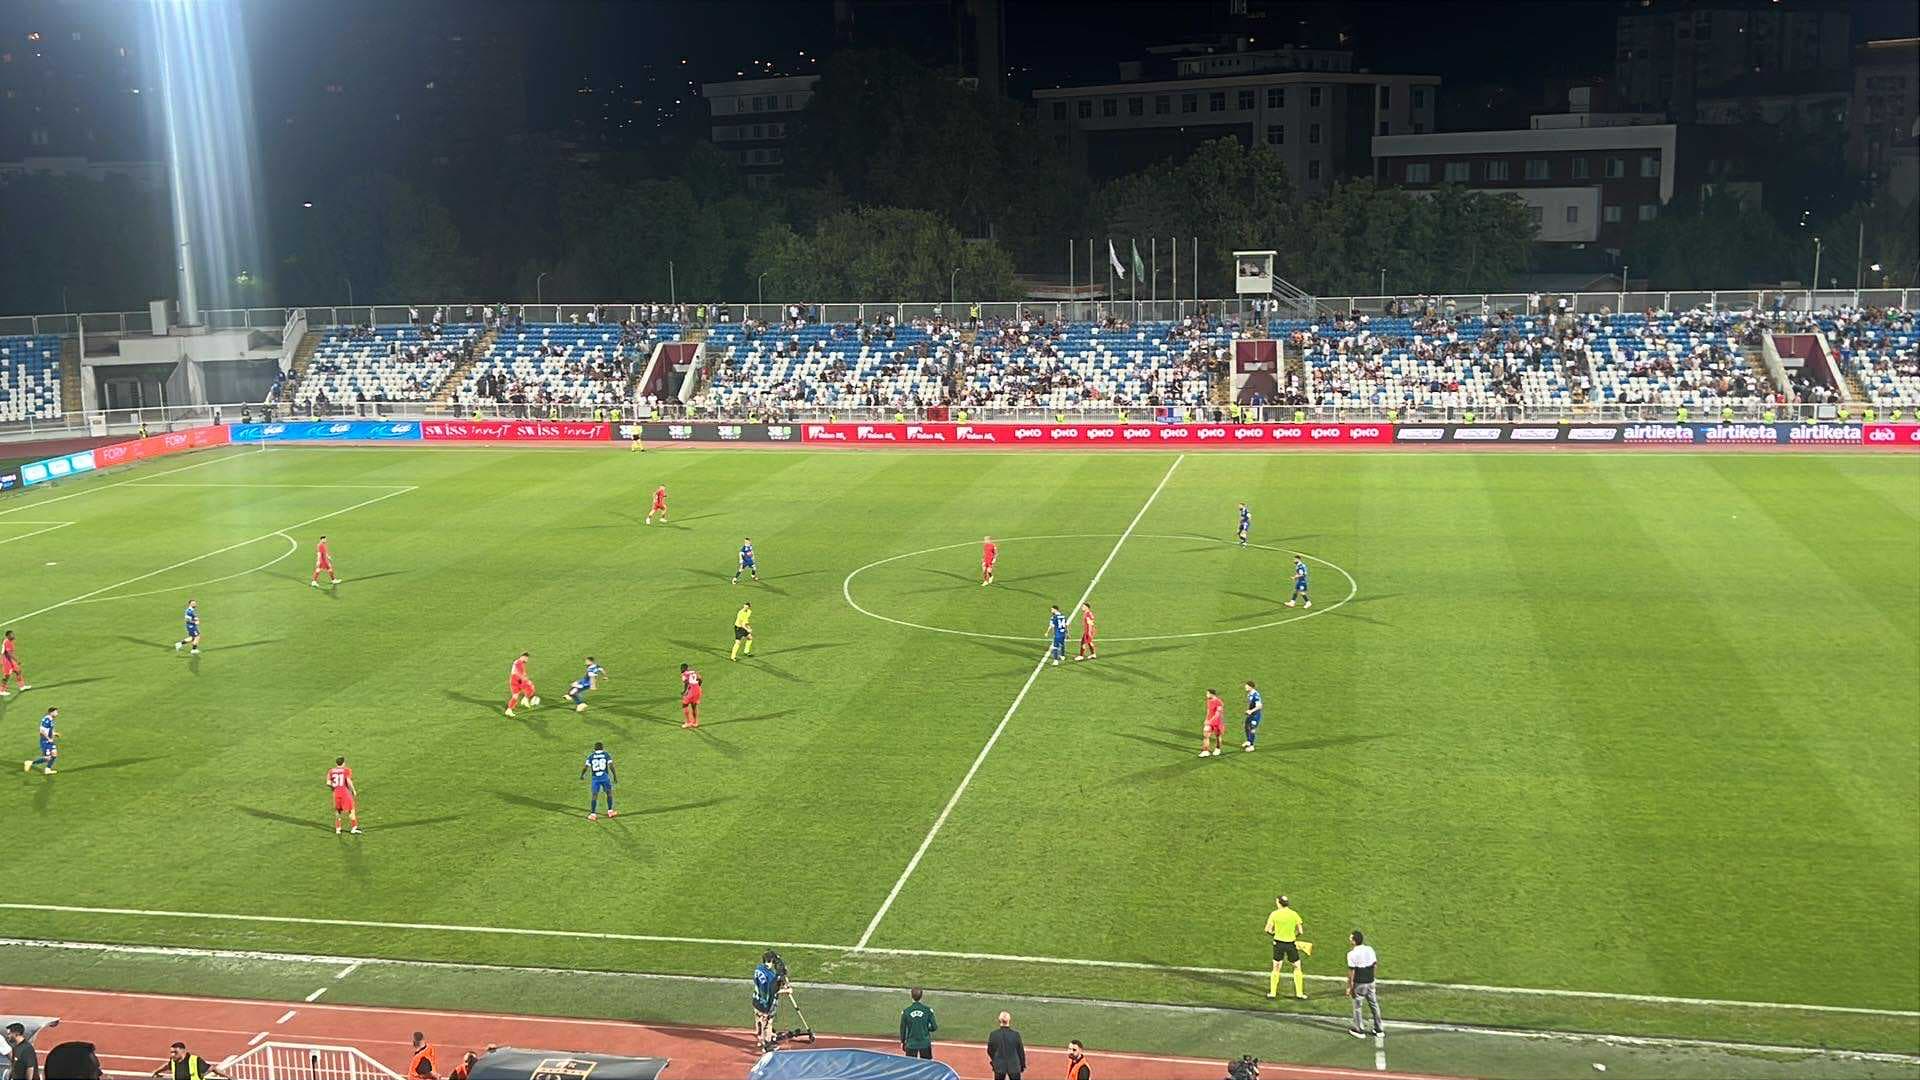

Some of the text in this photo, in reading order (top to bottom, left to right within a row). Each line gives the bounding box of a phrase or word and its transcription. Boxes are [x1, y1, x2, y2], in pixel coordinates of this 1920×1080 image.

[1624, 425, 1693, 439] airtiketa
[1706, 425, 1777, 439] airtiketa
[1790, 425, 1861, 439] airtiketa
[331, 773, 345, 787] 31
